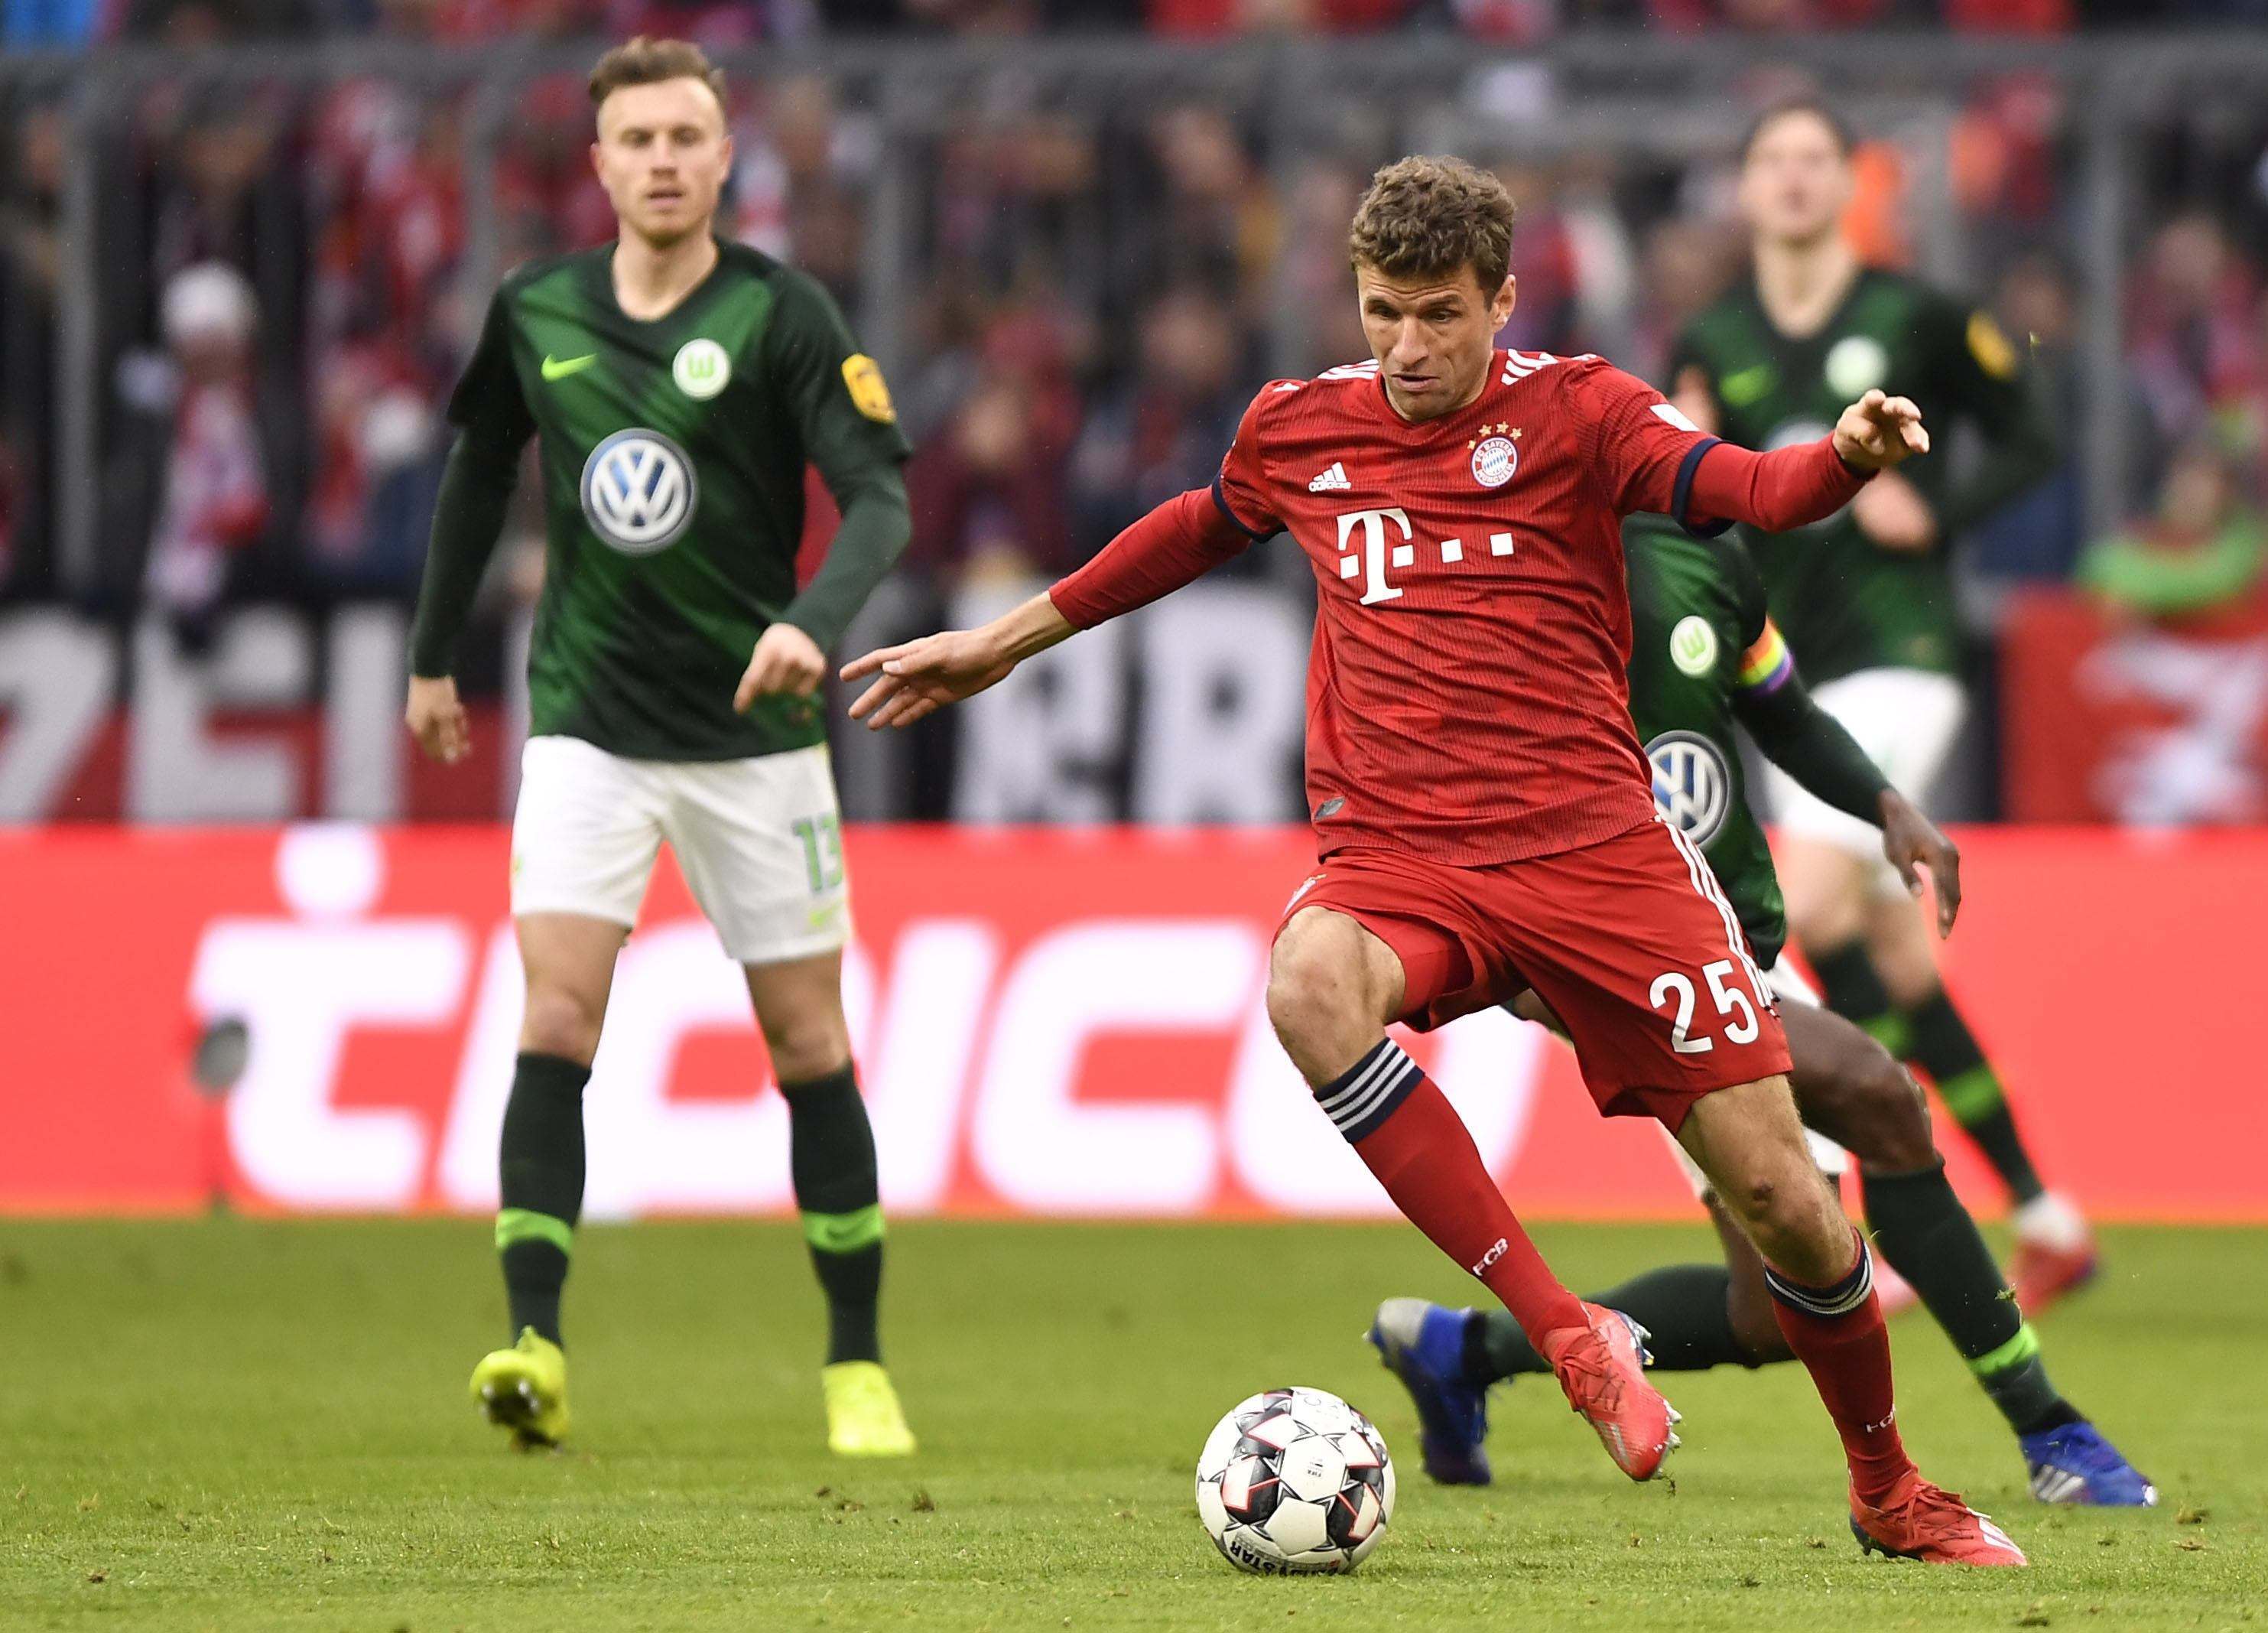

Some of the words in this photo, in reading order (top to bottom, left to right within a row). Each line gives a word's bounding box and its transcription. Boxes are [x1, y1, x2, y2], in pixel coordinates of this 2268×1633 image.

[1483, 440, 1513, 457] BAYERN
[1649, 958, 1759, 1052] 25
[1472, 1238, 1509, 1277] FCB
